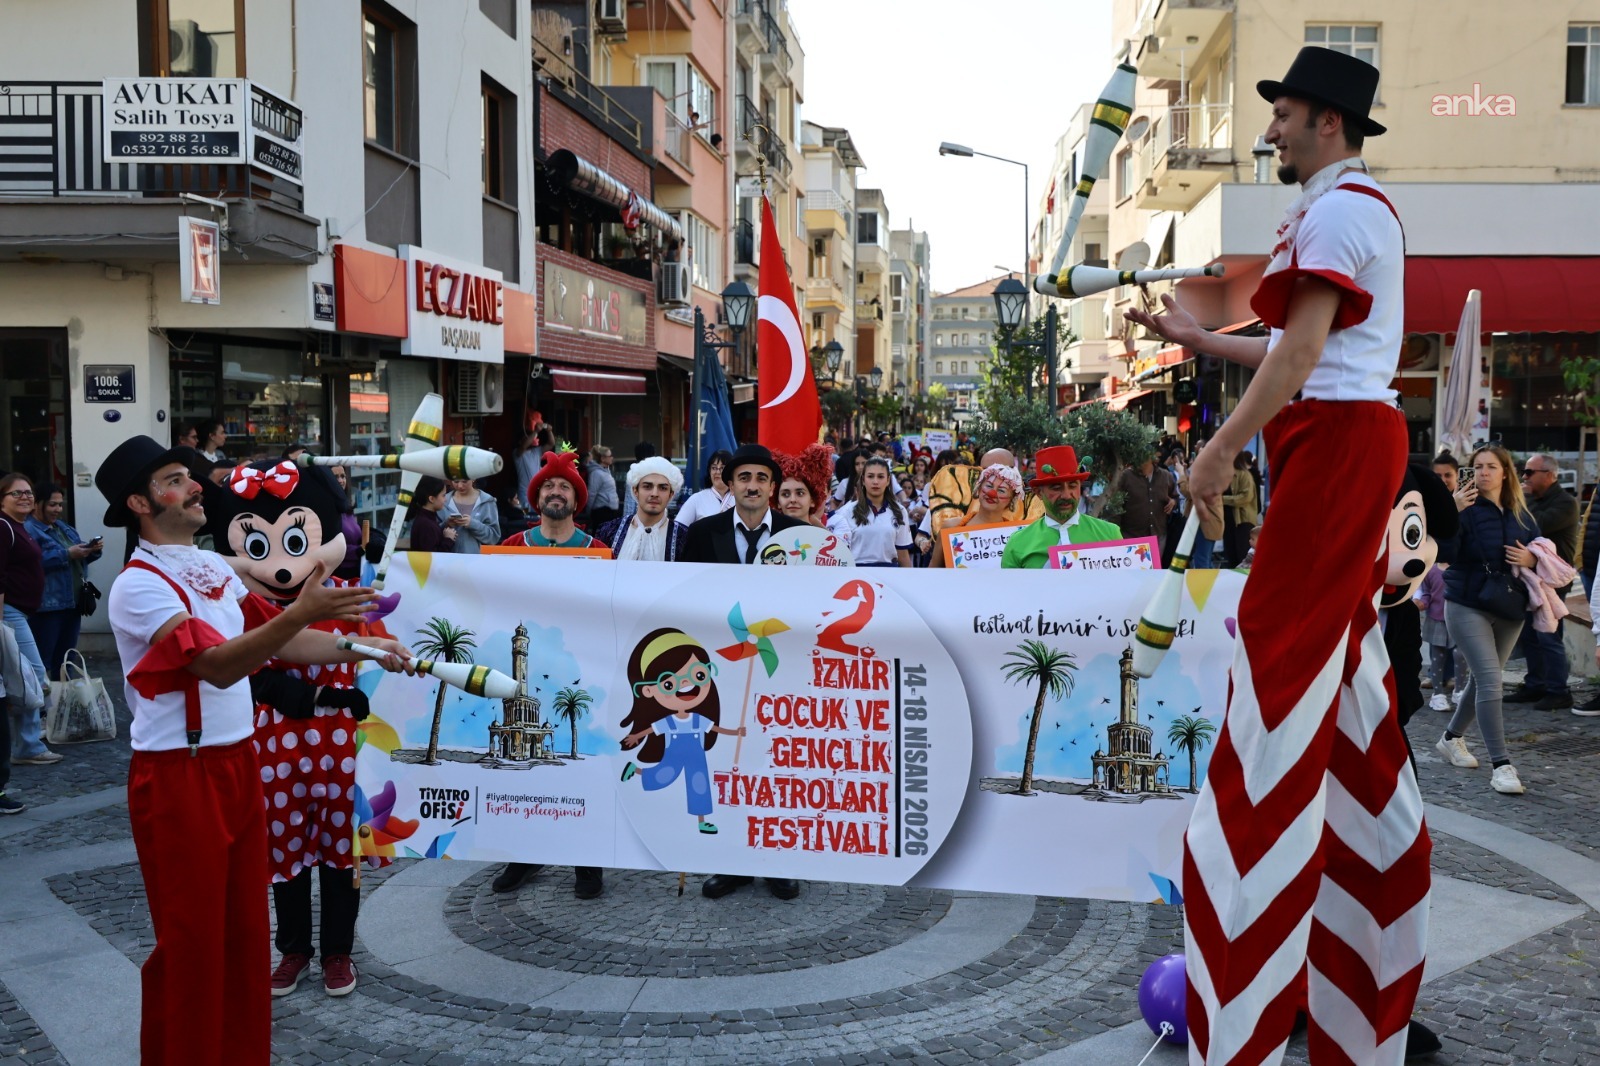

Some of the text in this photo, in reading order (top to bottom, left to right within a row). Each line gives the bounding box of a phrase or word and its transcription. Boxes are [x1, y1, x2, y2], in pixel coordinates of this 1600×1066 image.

[113, 83, 238, 105] AVUKAT
[114, 109, 235, 129] Salih Tosya
[139, 133, 207, 143] 892 88 21
[121, 145, 156, 155] 0532
[160, 145, 187, 155] 716
[190, 145, 208, 155] 56
[212, 145, 229, 155] 88
[269, 143, 280, 156] 892
[281, 149, 290, 160] 88
[258, 151, 274, 166] 0532
[275, 158, 286, 170] 716
[286, 164, 294, 174] 56
[415, 259, 504, 326] ECZANE
[441, 325, 481, 354] BAŞARAN
[94, 375, 122, 387] 1006.
[819, 535, 838, 557] 2
[1079, 555, 1132, 570] Tiyatro
[814, 579, 876, 656] 2
[973, 613, 1034, 634] Festival
[811, 648, 890, 691] İZMİR
[756, 695, 890, 733] ÇOCUK VE
[771, 733, 891, 776] GENÇLİK
[903, 664, 932, 856] 14-18 NİSAN 2026
[714, 766, 889, 814] TİYATROLARI
[486, 802, 520, 816] Tiyatro
[561, 796, 585, 807] #izcog
[747, 812, 889, 856] FESTİVALİ
